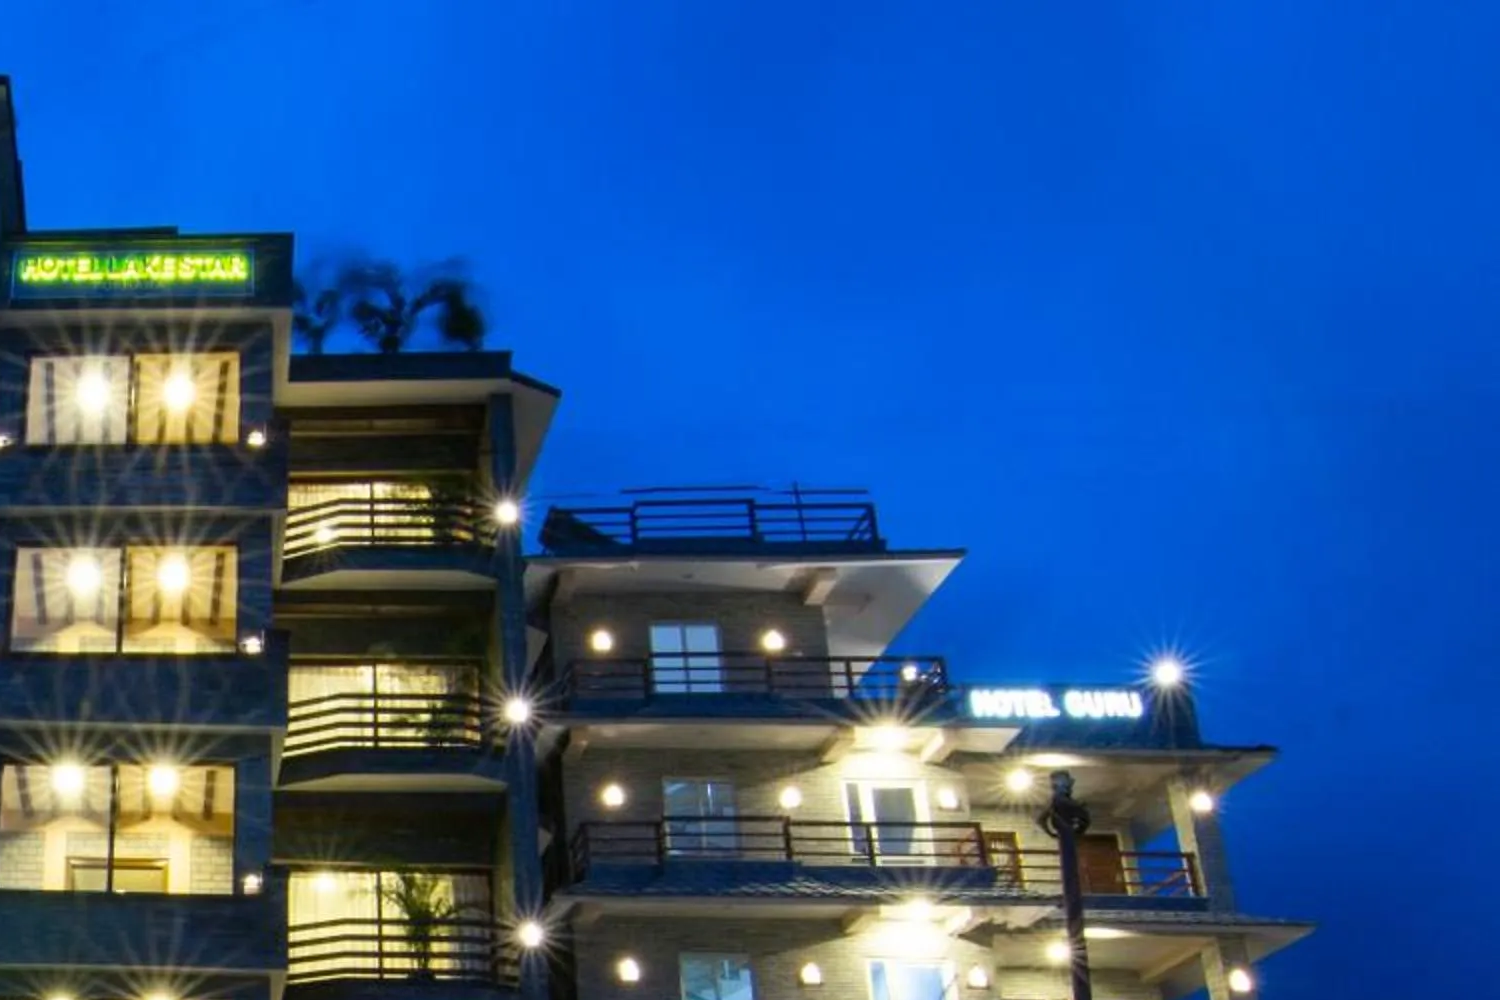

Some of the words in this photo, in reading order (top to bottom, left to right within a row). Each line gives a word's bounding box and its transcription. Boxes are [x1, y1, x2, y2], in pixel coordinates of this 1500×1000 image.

[21, 256, 102, 280] HOTEL
[106, 255, 176, 279] LAKE
[177, 254, 247, 279] STAR
[970, 688, 1060, 718] HOTEL
